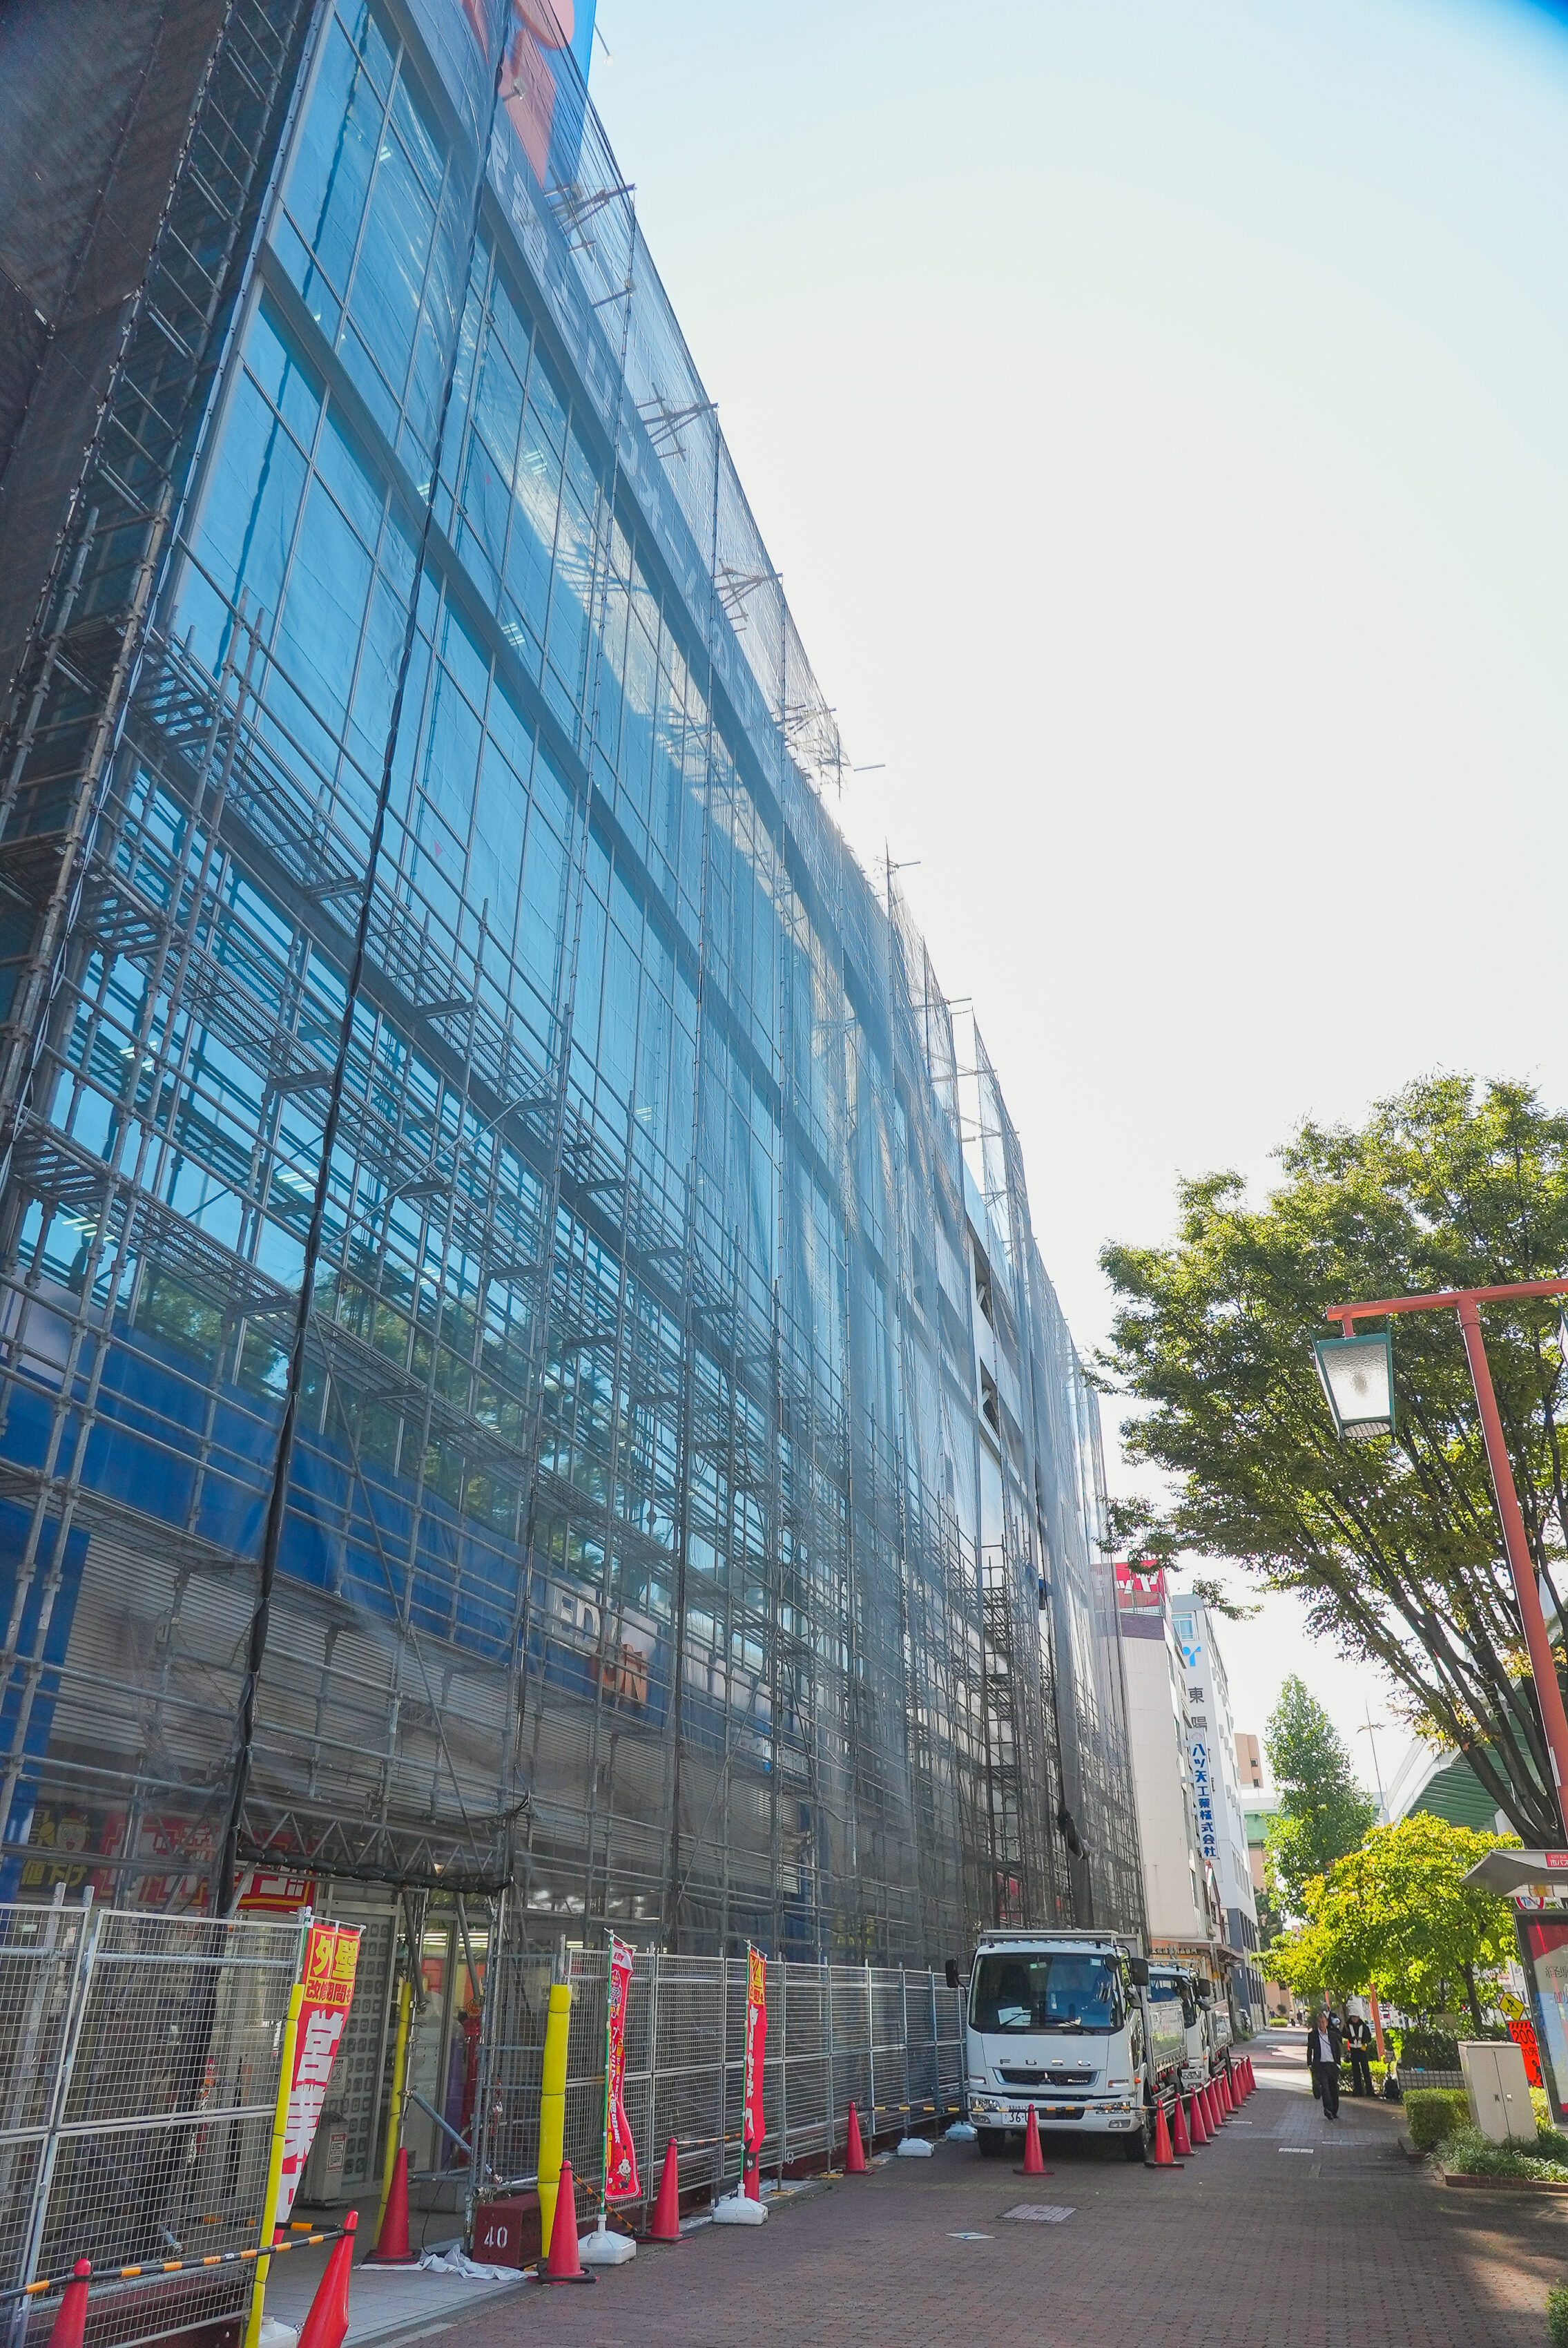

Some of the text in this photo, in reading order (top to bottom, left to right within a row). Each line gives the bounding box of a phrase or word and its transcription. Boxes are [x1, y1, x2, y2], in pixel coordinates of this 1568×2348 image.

[313, 1934, 358, 1979] 外壁
[1512, 2029, 1536, 2043] 200
[484, 2226, 508, 2249] 40
